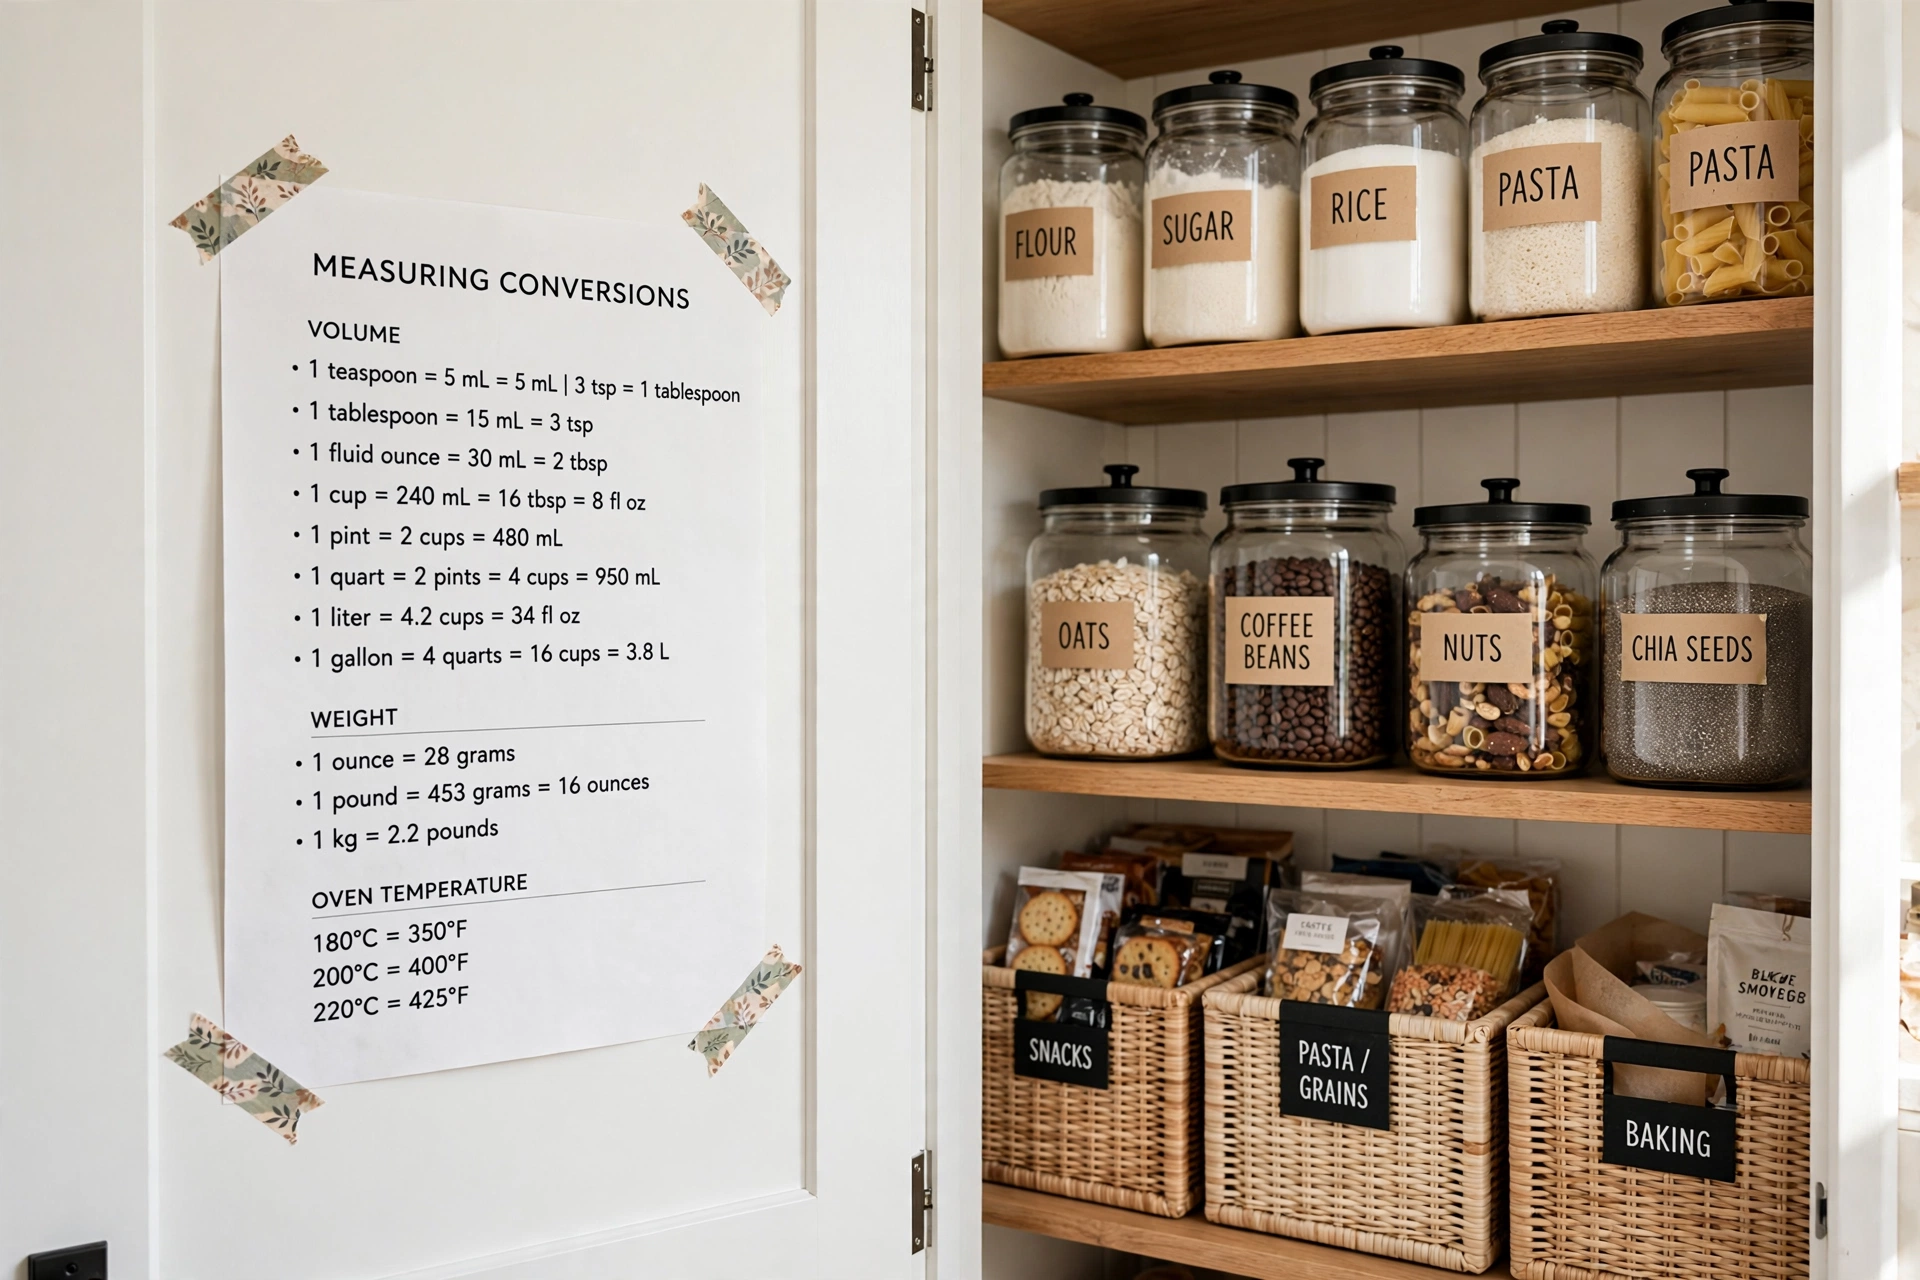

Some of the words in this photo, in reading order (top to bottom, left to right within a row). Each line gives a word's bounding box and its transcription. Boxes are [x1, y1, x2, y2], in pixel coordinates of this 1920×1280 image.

[1691, 144, 1774, 186] PASTA
[1500, 165, 1578, 206] PASTA
[1333, 188, 1386, 224] RICE
[1016, 227, 1076, 259] FLOUR
[1164, 211, 1233, 245] SUGAR
[314, 253, 488, 291] MEASURING
[500, 272, 689, 309] CONVERSIONS
[308, 320, 400, 344] VOLUME
[310, 359, 316, 378] 1
[328, 363, 416, 387] teaspoon
[445, 368, 455, 386] 5
[463, 370, 489, 388] mL
[497, 377, 508, 385] =
[515, 373, 525, 390] 5
[532, 374, 557, 392] mL
[575, 376, 585, 394] 3
[591, 380, 616, 400] tsp
[641, 381, 646, 397] 1
[655, 381, 740, 406] tablespoon
[310, 401, 317, 420] 1
[328, 402, 437, 429] tablespoon
[467, 409, 489, 428] 15
[497, 411, 523, 429] mL
[531, 418, 542, 426] =
[550, 413, 560, 431] 3
[567, 416, 593, 437] tsp
[310, 442, 317, 461] 1
[329, 442, 373, 463] fluid
[381, 451, 440, 465] ounce
[468, 448, 492, 467] 30
[499, 450, 526, 468] mL
[553, 452, 563, 470] 2
[570, 452, 607, 476] tbsp
[311, 484, 318, 502] 1
[330, 490, 366, 509] cup
[375, 491, 388, 499] =
[397, 485, 434, 505] 240
[443, 487, 470, 506] mL
[499, 489, 521, 507] 16
[527, 489, 566, 514] tbsp
[593, 491, 603, 509] 8
[610, 491, 620, 510] fl
[627, 498, 646, 510] oz
[311, 525, 318, 543] 1
[331, 526, 370, 550] pint
[379, 532, 392, 540] =
[401, 526, 412, 545] 2
[420, 532, 464, 551] cups
[493, 528, 529, 546] 480
[537, 529, 563, 547] mL
[312, 566, 319, 585] 1
[331, 569, 385, 591] quart
[415, 566, 426, 585] 2
[435, 567, 480, 591] pints
[509, 567, 520, 585] 4
[527, 573, 568, 590] cups
[596, 567, 628, 585] 950
[636, 568, 660, 585] mL
[312, 608, 319, 627] 1
[332, 606, 371, 626] liter
[380, 613, 392, 621] =
[401, 606, 432, 625] 4.2
[440, 612, 484, 630] cups
[492, 612, 503, 620] =
[512, 606, 535, 624] 34
[542, 605, 552, 624] fl
[560, 611, 580, 624] oz
[1241, 613, 1312, 637] COFFEE
[1059, 622, 1109, 649] OATS
[1445, 634, 1501, 662] NUTS
[1633, 635, 1677, 661] CHIA
[1687, 636, 1752, 662] SEEDS
[312, 648, 319, 667] 1
[331, 647, 392, 673] gallon
[423, 646, 435, 665] 4
[443, 648, 502, 670] quarts
[531, 644, 552, 662] 16
[559, 649, 600, 667] cups
[627, 642, 653, 660] 3.8
[660, 642, 669, 660] L
[1245, 644, 1309, 669] BEANS
[311, 708, 398, 728] WEIGHT
[313, 753, 320, 771] 1
[332, 755, 394, 770] ounce
[403, 754, 415, 762] =
[425, 746, 449, 765] 28
[457, 749, 515, 769] grams
[313, 791, 320, 810] 1
[333, 786, 397, 815] pound
[407, 791, 419, 799] =
[428, 783, 465, 802] 453
[473, 784, 530, 805] grams
[559, 776, 580, 794] 16
[587, 777, 649, 793] ounces
[314, 830, 321, 849] 1
[333, 828, 357, 852] kg
[366, 832, 379, 840] =
[388, 823, 419, 844] 2.2
[428, 818, 498, 846] pounds
[312, 888, 372, 909] OVEN
[380, 874, 527, 903] TEMPERATURE
[314, 928, 378, 953] 180°C
[387, 932, 399, 940] =
[409, 919, 467, 943] 350°F
[313, 962, 378, 988] 200°C
[387, 966, 400, 974] =
[408, 953, 468, 976] 400°F
[314, 996, 378, 1022] 220°C
[388, 999, 400, 1008] =
[409, 986, 469, 1009] 425°F
[1030, 1038, 1091, 1069] SNACKS
[1300, 1040, 1353, 1071] PASTA
[1361, 1049, 1370, 1073] /
[1300, 1075, 1367, 1108] GRAINS
[1627, 1120, 1710, 1157] BAKING
